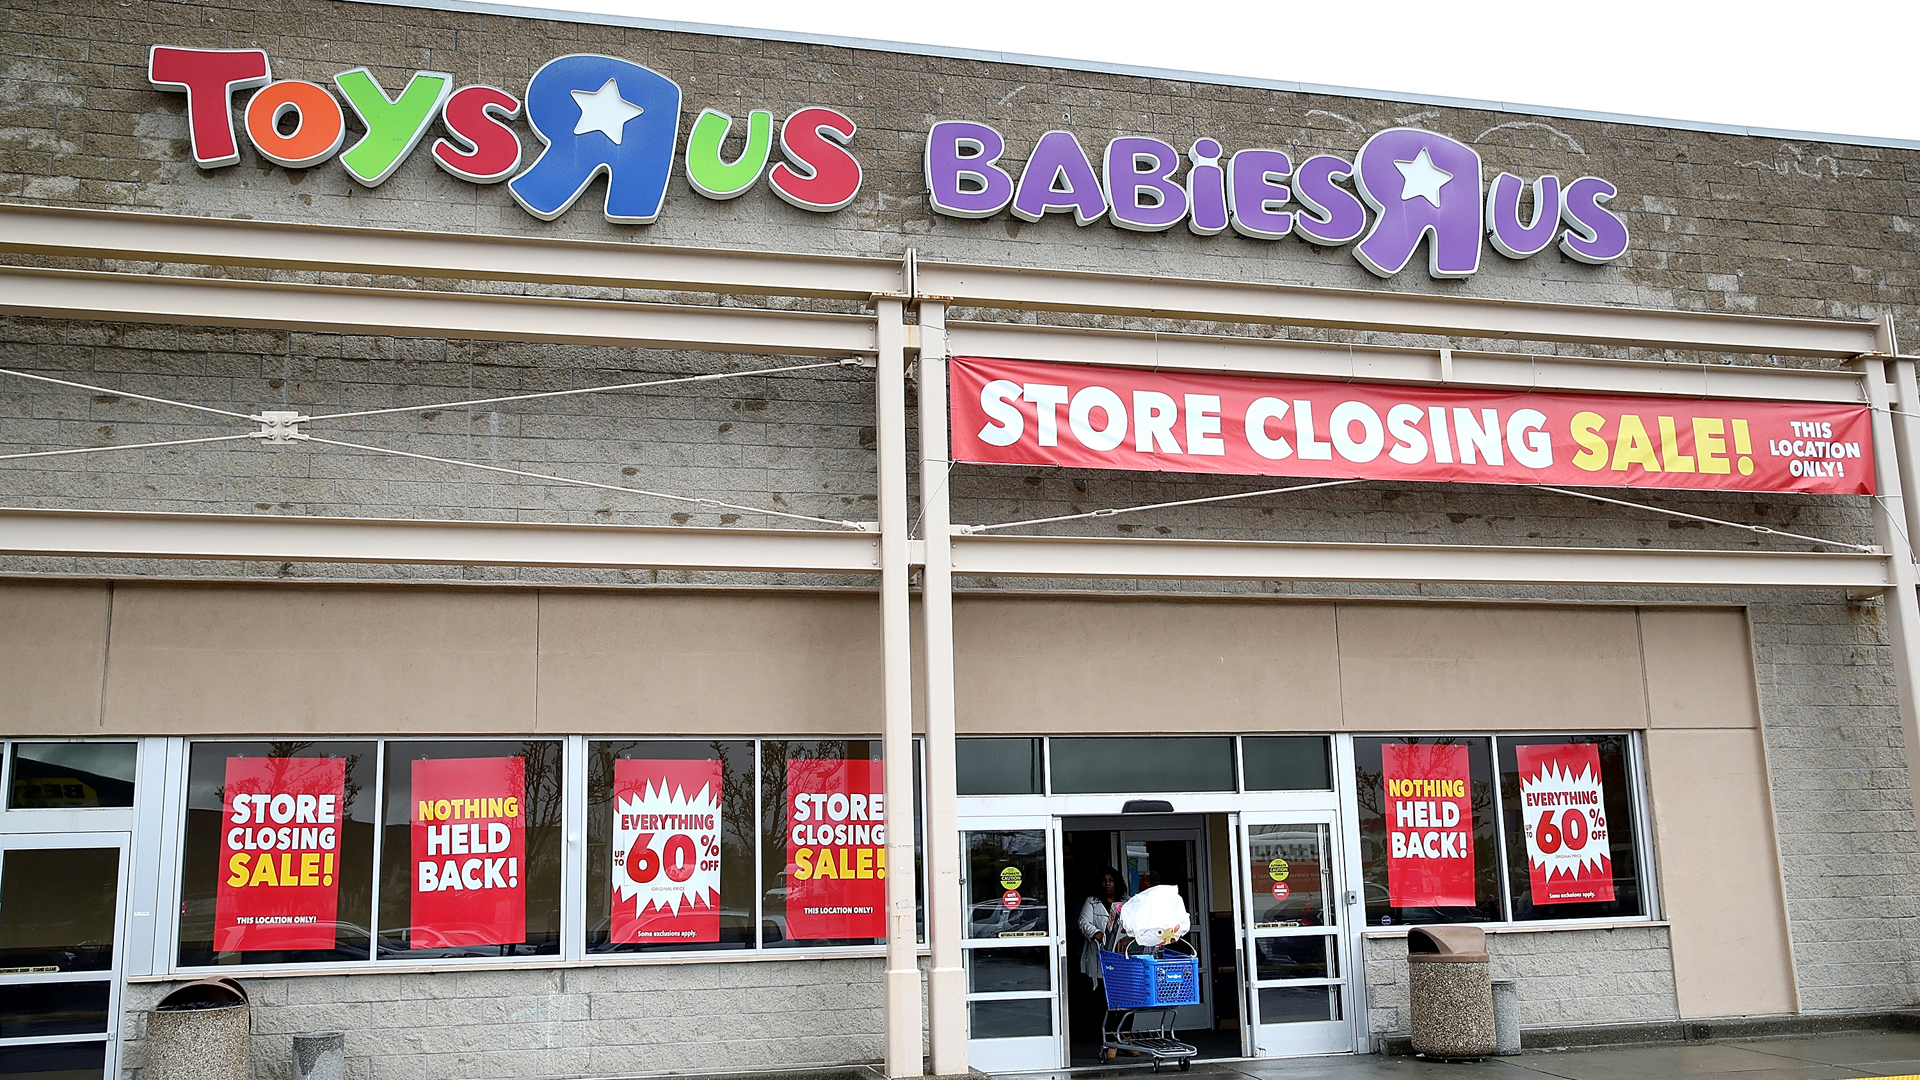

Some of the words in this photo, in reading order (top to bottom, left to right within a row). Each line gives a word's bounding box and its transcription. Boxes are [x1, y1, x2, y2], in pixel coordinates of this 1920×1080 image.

[977, 379, 1226, 456] STORE
[1244, 396, 1554, 469] CLOSING
[1569, 411, 1755, 476] SALE!
[1790, 421, 1833, 438] THIS
[1769, 439, 1861, 458] LOCATION
[1789, 459, 1845, 478] ONLY!
[1389, 779, 1465, 798] NOTHING
[1526, 790, 1598, 807] EVERYTHING
[230, 793, 336, 824] STORE
[419, 797, 519, 821] NOTHING
[793, 793, 885, 821] STORE
[1396, 801, 1460, 828] HELD
[621, 814, 715, 830] EVERYTHING
[1536, 808, 1588, 854] 60
[227, 827, 336, 850] CLOSING
[427, 822, 511, 856] HELD
[791, 824, 886, 846] CLOSING
[1391, 831, 1467, 859] BACK!
[1591, 830, 1607, 840] OFF
[614, 850, 625, 858] UP
[614, 858, 625, 867] TO
[626, 832, 697, 884] 60
[793, 848, 887, 880] SALE!
[226, 852, 334, 888] SALE!
[418, 857, 518, 892] BACK!
[700, 860, 719, 871] OFF
[236, 917, 254, 925] THIS
[255, 916, 293, 924] LOCATION
[293, 916, 317, 924] ONLY!
[681, 930, 698, 939] apply.
